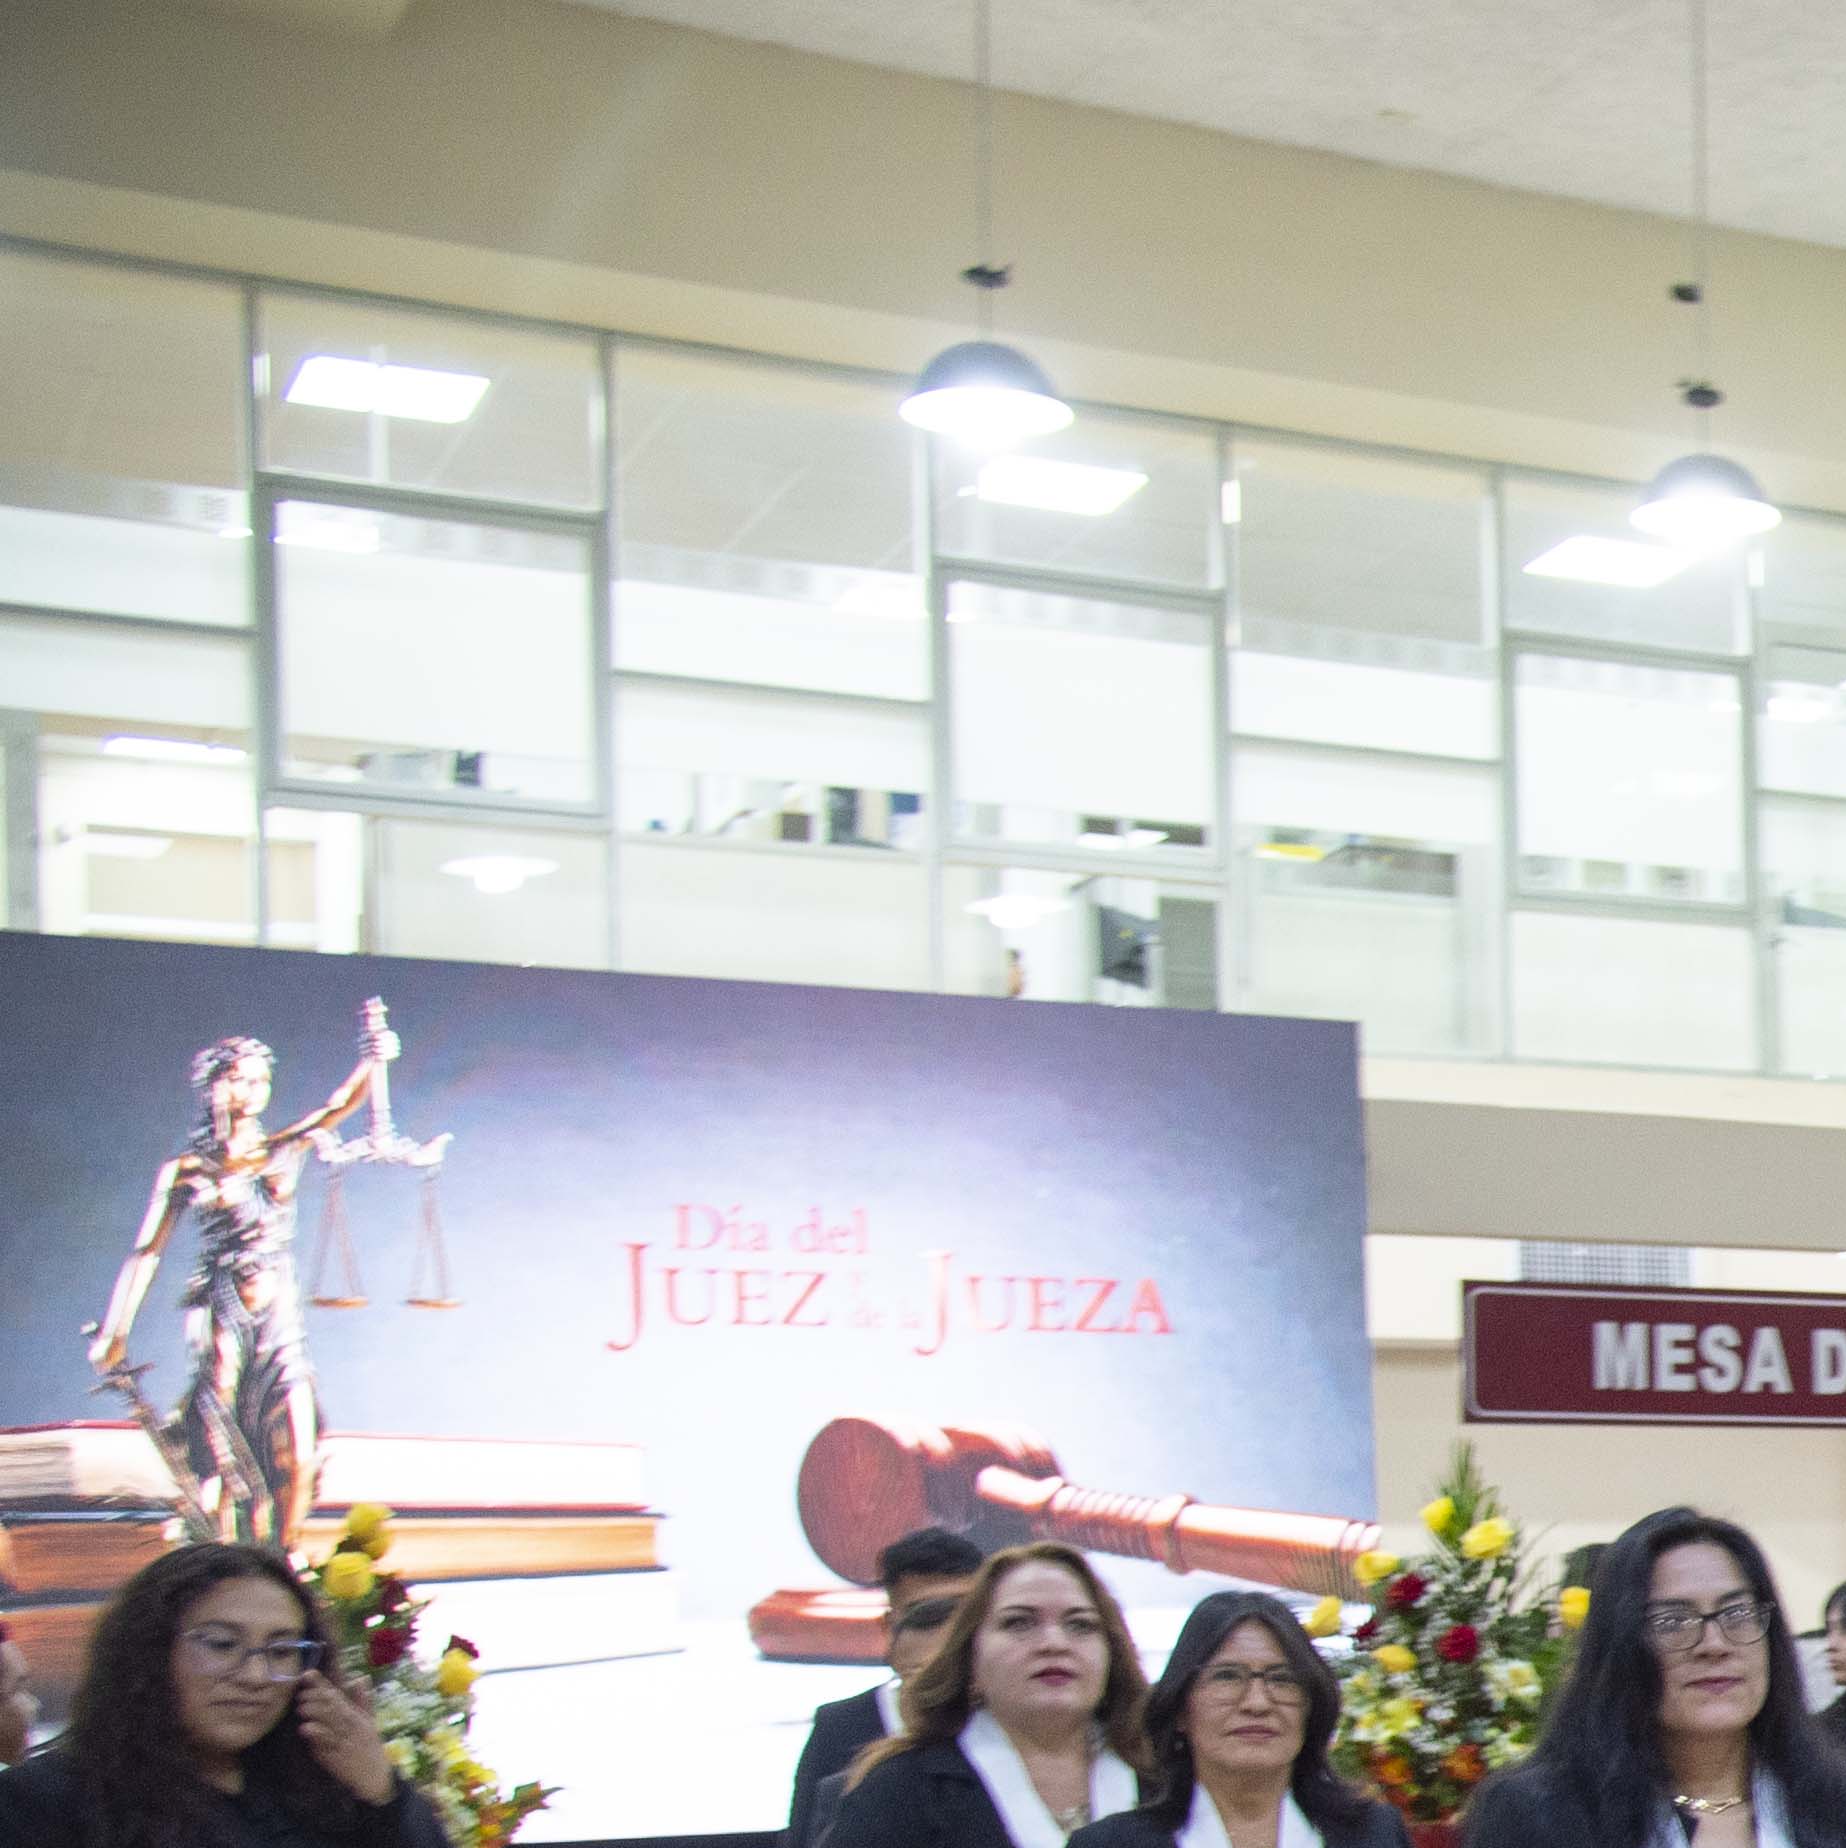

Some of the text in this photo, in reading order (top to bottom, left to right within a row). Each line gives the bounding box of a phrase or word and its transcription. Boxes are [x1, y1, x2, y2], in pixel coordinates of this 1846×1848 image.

[673, 1203, 871, 1256] Día del
[606, 1243, 830, 1352] JUEZ
[913, 1251, 1176, 1357] JUEZA
[1592, 1321, 1794, 1394] MESA
